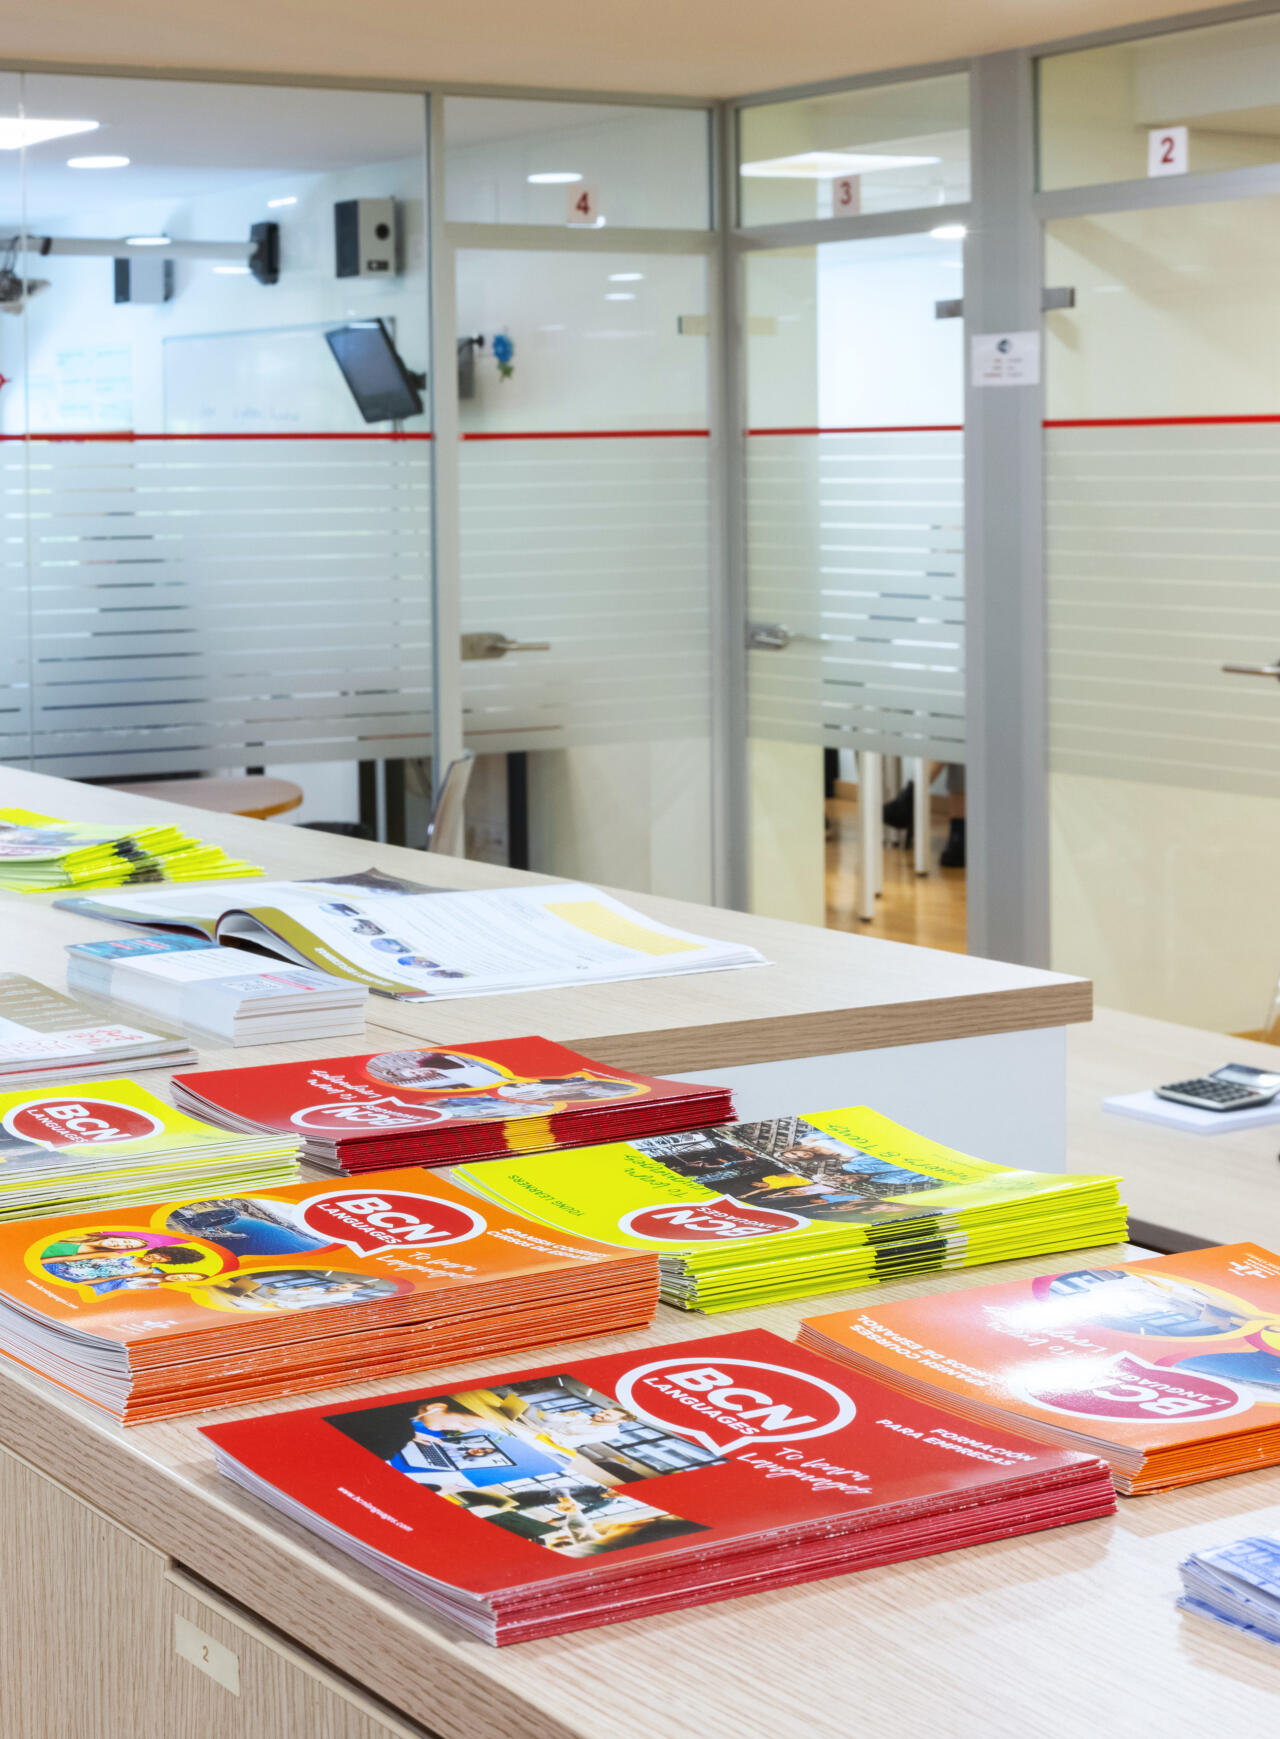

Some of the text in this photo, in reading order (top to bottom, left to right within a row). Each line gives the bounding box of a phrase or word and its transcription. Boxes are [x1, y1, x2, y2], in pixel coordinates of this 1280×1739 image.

[1160, 136, 1175, 164] 2
[576, 190, 591, 216] 4
[840, 181, 852, 206] 3
[26, 1108, 89, 1144] LANGUAGES
[43, 1103, 132, 1141] BCN
[321, 1106, 417, 1126] BCN
[317, 1203, 402, 1246] LANGUAGES
[336, 1196, 451, 1241] BCN
[651, 1209, 771, 1238] BCN
[696, 1206, 791, 1231] LANGUAGES
[850, 1323, 921, 1360] COURSES
[642, 1377, 761, 1437] LANGUAGES
[664, 1367, 817, 1432] BCN
[875, 1419, 1017, 1467] PARA EMPRESAS
[930, 1427, 1037, 1463] FORMACIÓN
[736, 1452, 873, 1496] Languages
[775, 1446, 872, 1483] To learn
[202, 1644, 209, 1663] 2
